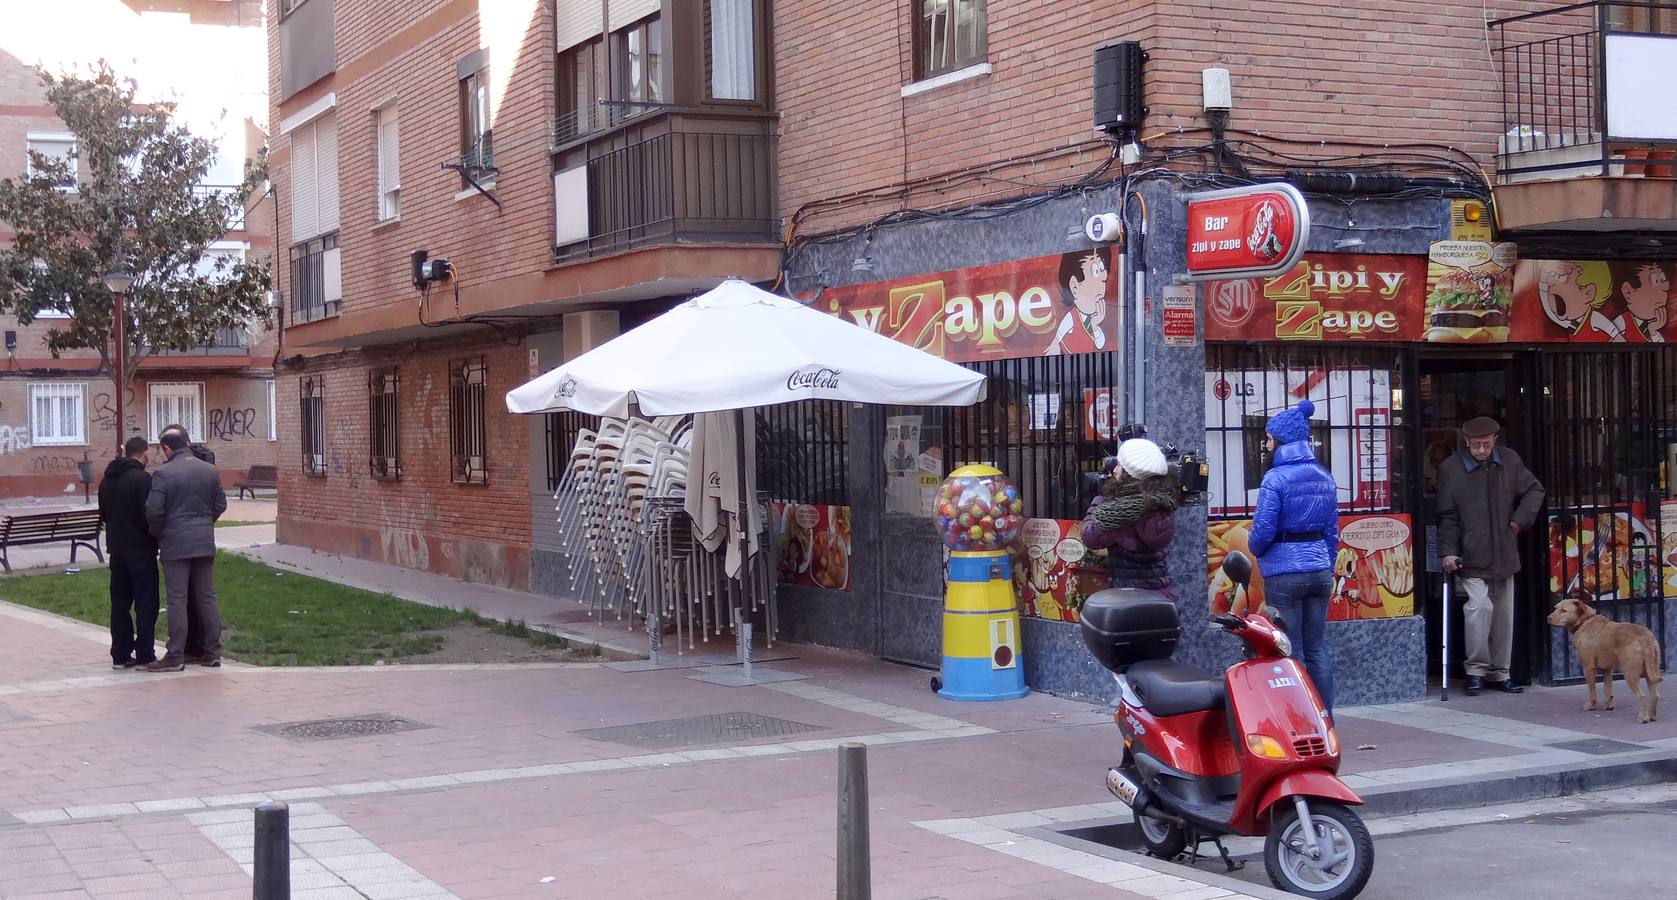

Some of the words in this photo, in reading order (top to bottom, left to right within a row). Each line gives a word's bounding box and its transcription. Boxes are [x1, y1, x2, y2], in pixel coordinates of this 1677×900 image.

[1204, 216, 1229, 232] Bar
[1191, 241, 1208, 253] zipi
[1210, 242, 1217, 252] y
[1218, 238, 1241, 251] zape
[1264, 260, 1370, 297] Zipi
[1375, 271, 1405, 297] y
[889, 279, 1055, 358] Zape
[1165, 311, 1193, 319] Alarma
[1275, 301, 1399, 339] Zape
[787, 368, 842, 391] Coca-Cola
[1235, 383, 1255, 397] LG
[1342, 532, 1371, 541] PERRITO
